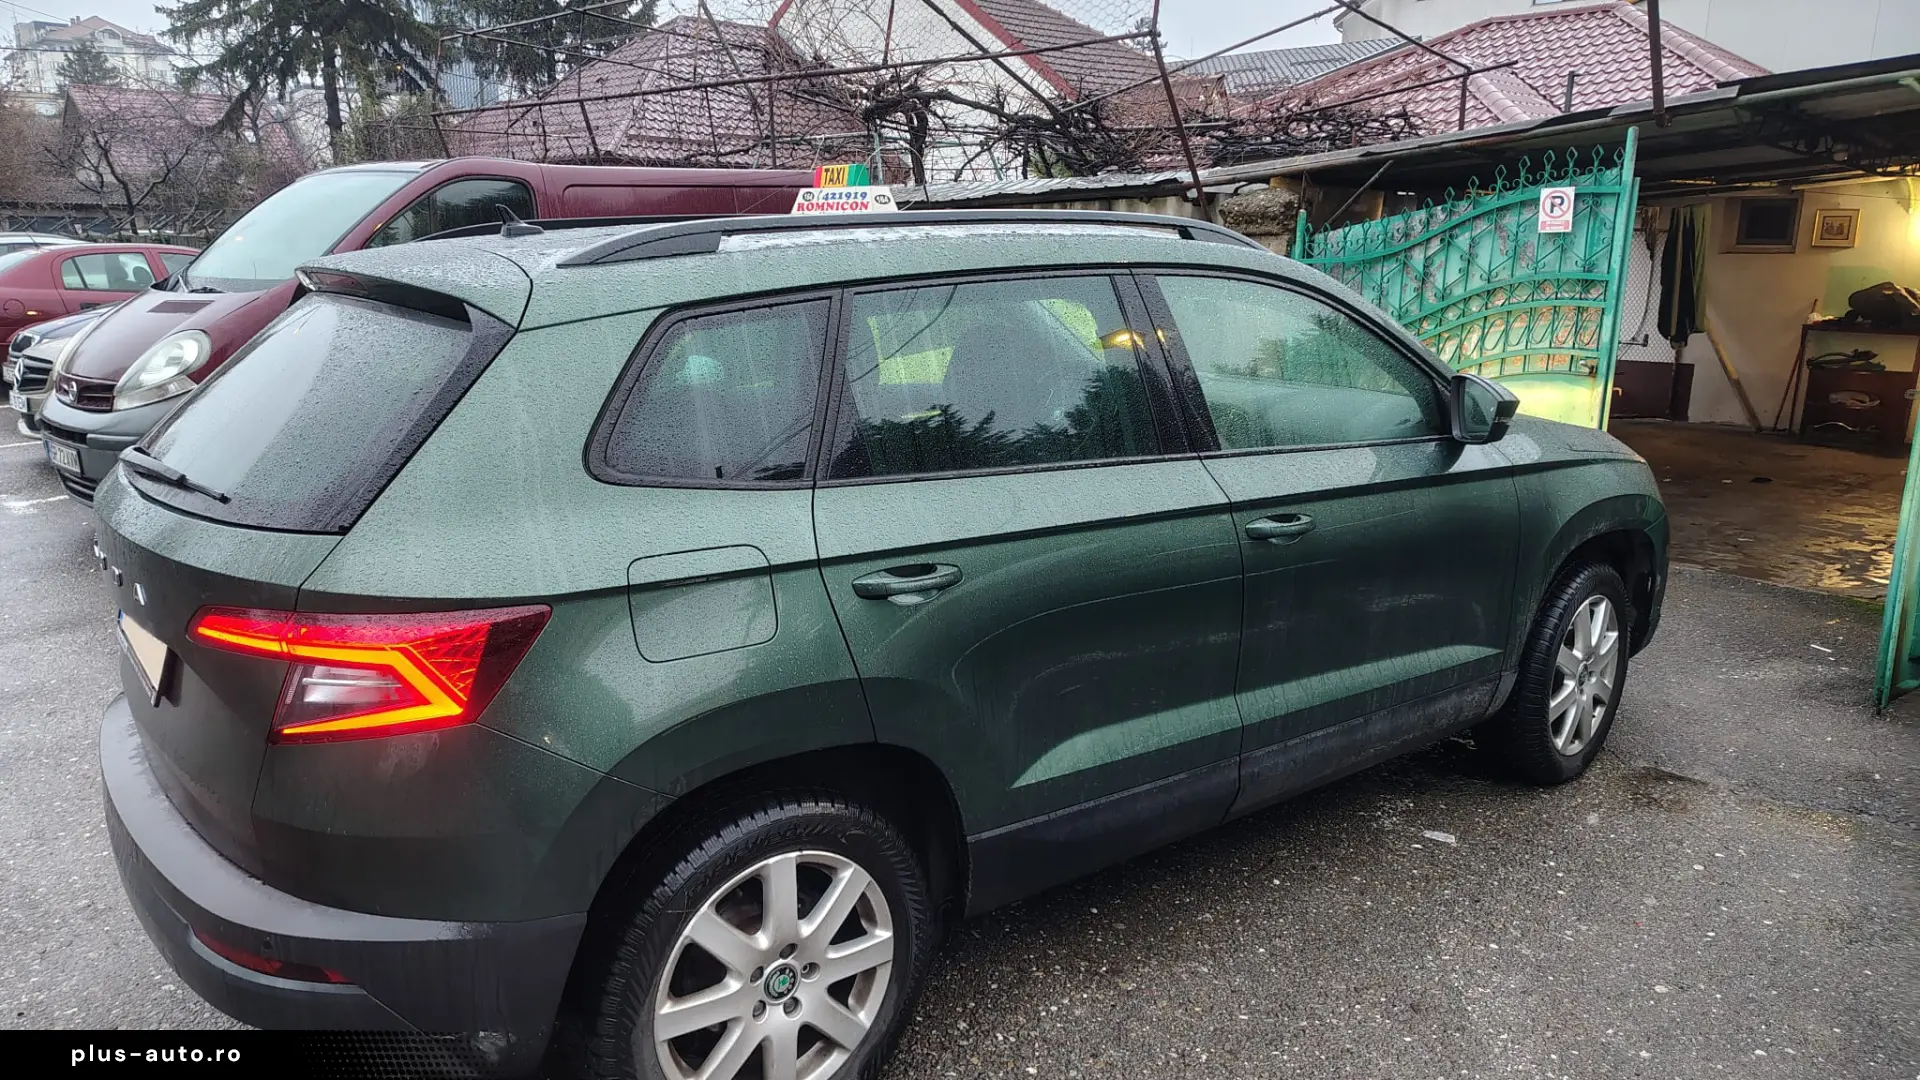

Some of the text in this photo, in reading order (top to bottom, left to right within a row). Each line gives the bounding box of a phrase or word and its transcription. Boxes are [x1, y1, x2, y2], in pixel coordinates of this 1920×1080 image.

[824, 167, 845, 185] TAXI
[822, 191, 868, 201] 421919
[796, 200, 870, 212] ROMNICON
